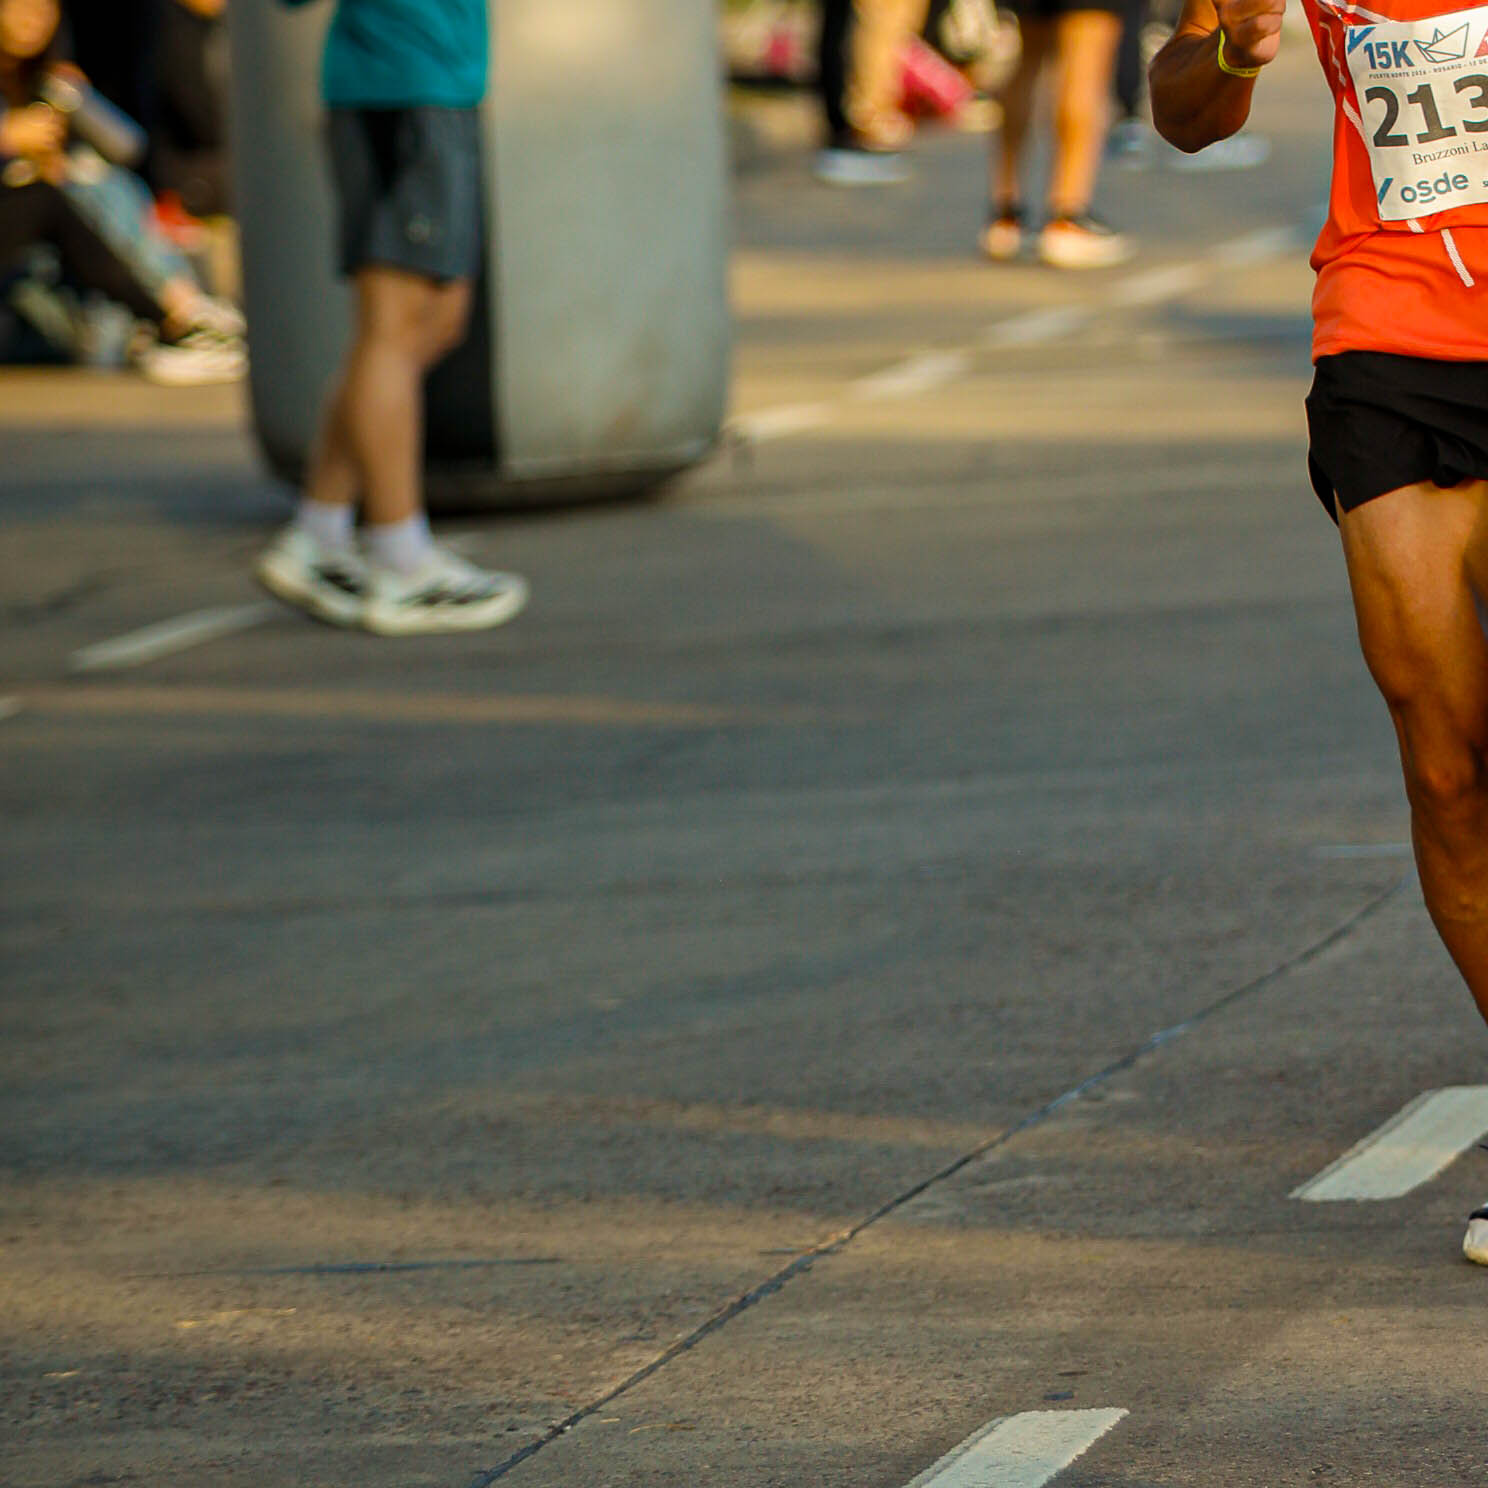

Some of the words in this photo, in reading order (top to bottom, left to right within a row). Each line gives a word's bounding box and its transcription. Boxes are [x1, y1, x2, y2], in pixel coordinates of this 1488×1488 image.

[1363, 40, 1416, 70] 15K
[1412, 142, 1470, 165] Bruzzoni
[1400, 171, 1469, 203] osde
